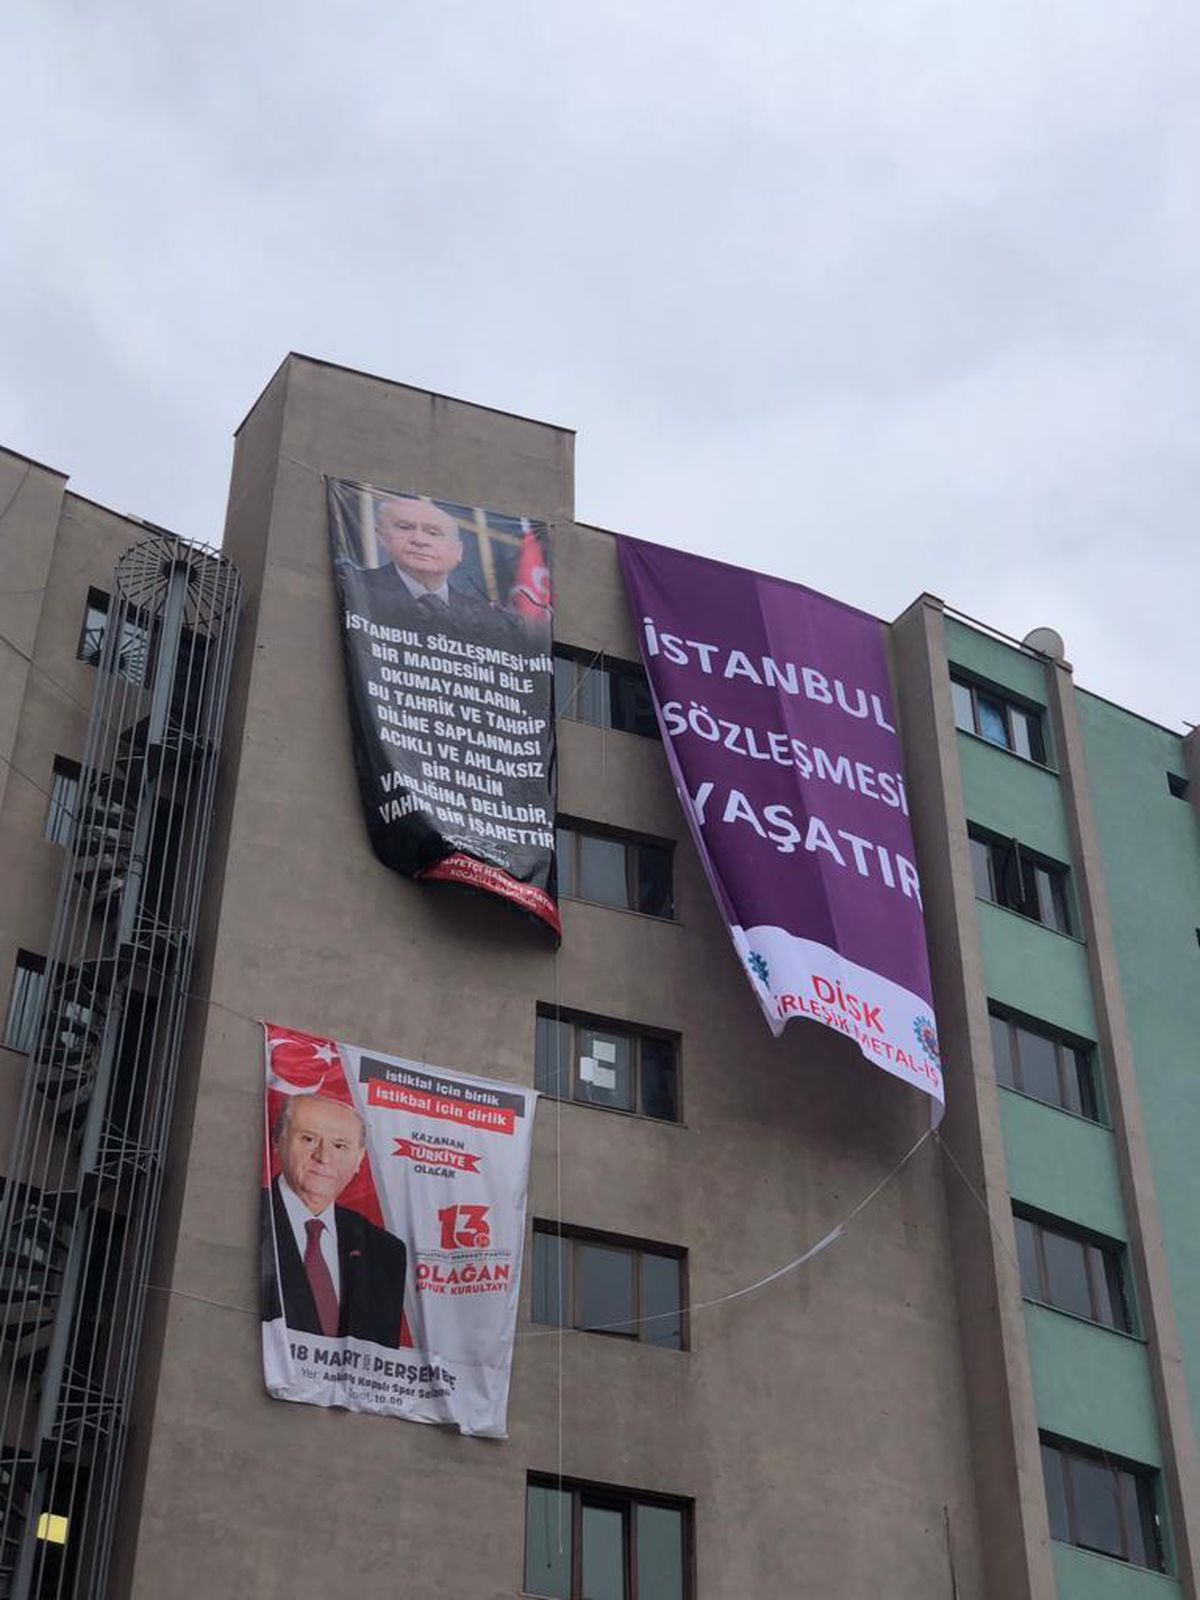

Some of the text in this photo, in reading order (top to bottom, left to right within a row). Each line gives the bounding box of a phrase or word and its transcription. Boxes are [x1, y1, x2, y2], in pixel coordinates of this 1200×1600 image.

[346, 611, 422, 647] İSTANBUL
[372, 643, 533, 693] BİR MADDESİNİ BİLE
[643, 617, 896, 733] İSTANBUL
[368, 682, 545, 735] BU TAHRİK VE TAHRİP
[381, 667, 527, 716] OKUMAYANLARIN,
[378, 705, 540, 756] DİLİNE SAPLANMASI
[438, 744, 459, 762] VE
[465, 751, 544, 778] AHLAKSIZ
[662, 701, 909, 816] SÖZLEŞMESİ
[381, 771, 467, 809] VARLIĞINA
[422, 761, 503, 797] BİR HALİN
[437, 807, 465, 827] BİR
[468, 813, 555, 850] İŞARETTİR
[690, 782, 923, 909] YAŞATIR
[774, 994, 849, 1033] İRLEŞİK
[812, 974, 885, 1034] DİSK
[376, 1086, 431, 1110] istikbal
[467, 1107, 507, 1126] dirlik
[386, 1070, 432, 1090] istiklal
[465, 1088, 500, 1106] birlik
[410, 1145, 466, 1167] TÜRKİYE
[411, 1131, 465, 1150] KAZANAN
[414, 1164, 456, 1178] OLACAK
[416, 1263, 510, 1284] OLAĞAN
[290, 1343, 308, 1360] 18
[314, 1348, 362, 1369] MART
